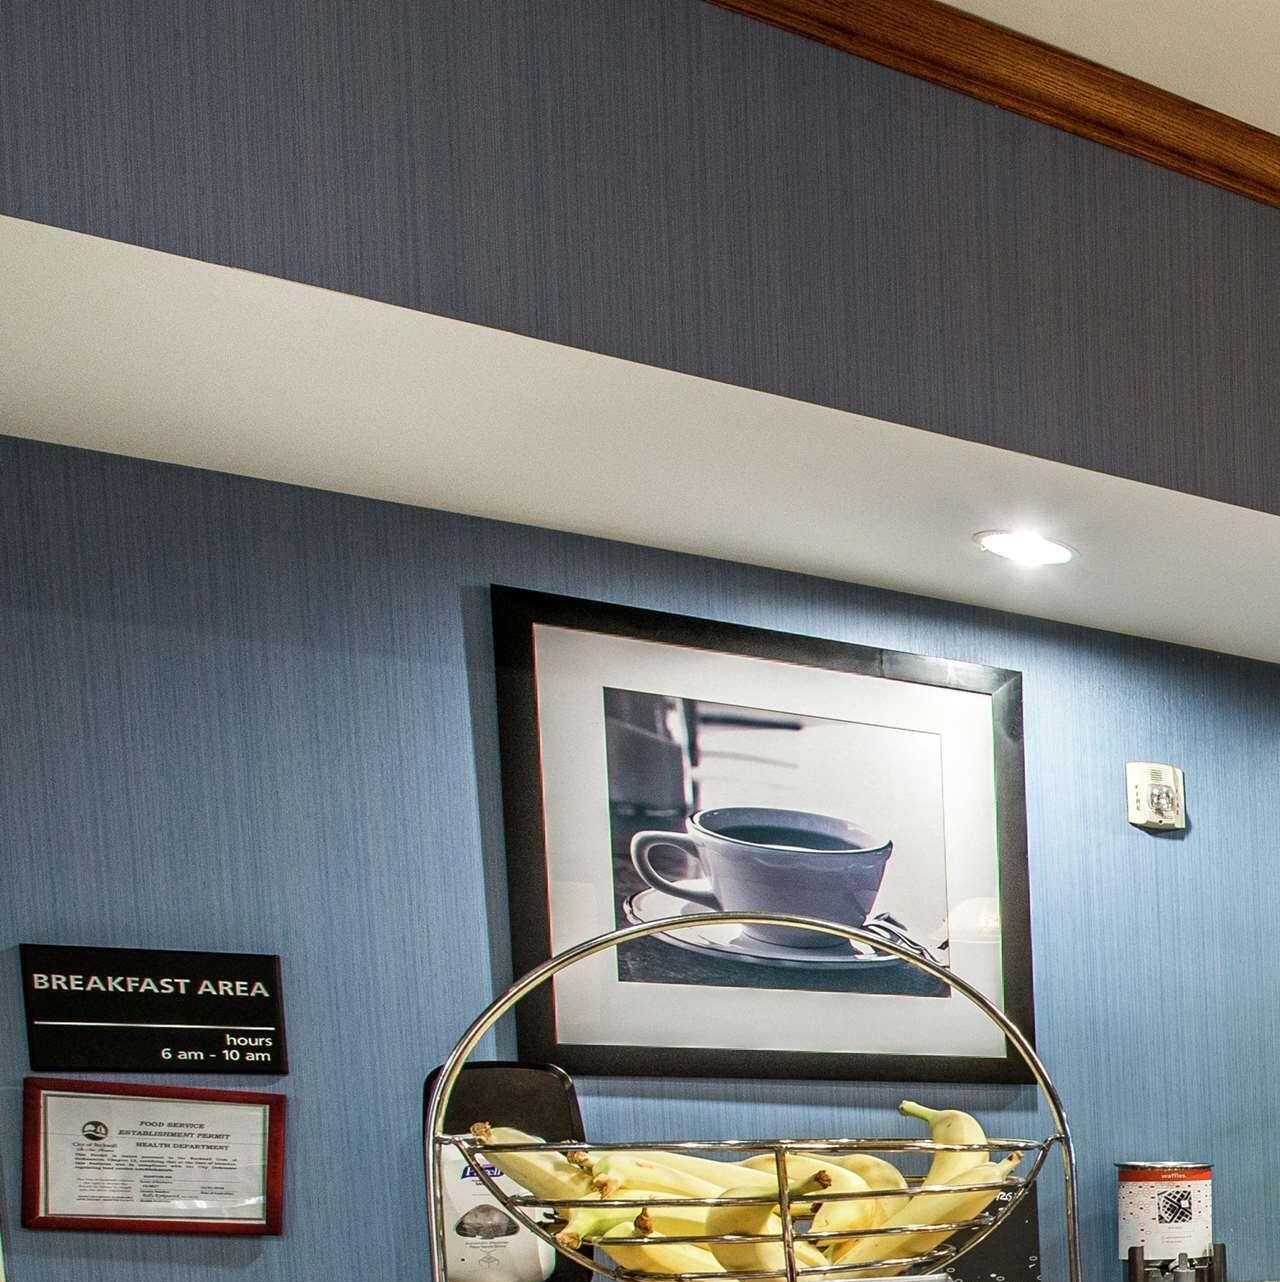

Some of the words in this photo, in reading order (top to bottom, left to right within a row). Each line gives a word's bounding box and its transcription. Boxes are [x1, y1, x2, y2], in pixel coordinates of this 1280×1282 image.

[32, 973, 191, 994] BREAKFAST
[197, 980, 270, 998] AREA
[225, 1033, 273, 1047] hours
[160, 1048, 172, 1060] 6
[177, 1051, 204, 1061] am
[222, 1049, 240, 1061] 10
[245, 1050, 271, 1062] am
